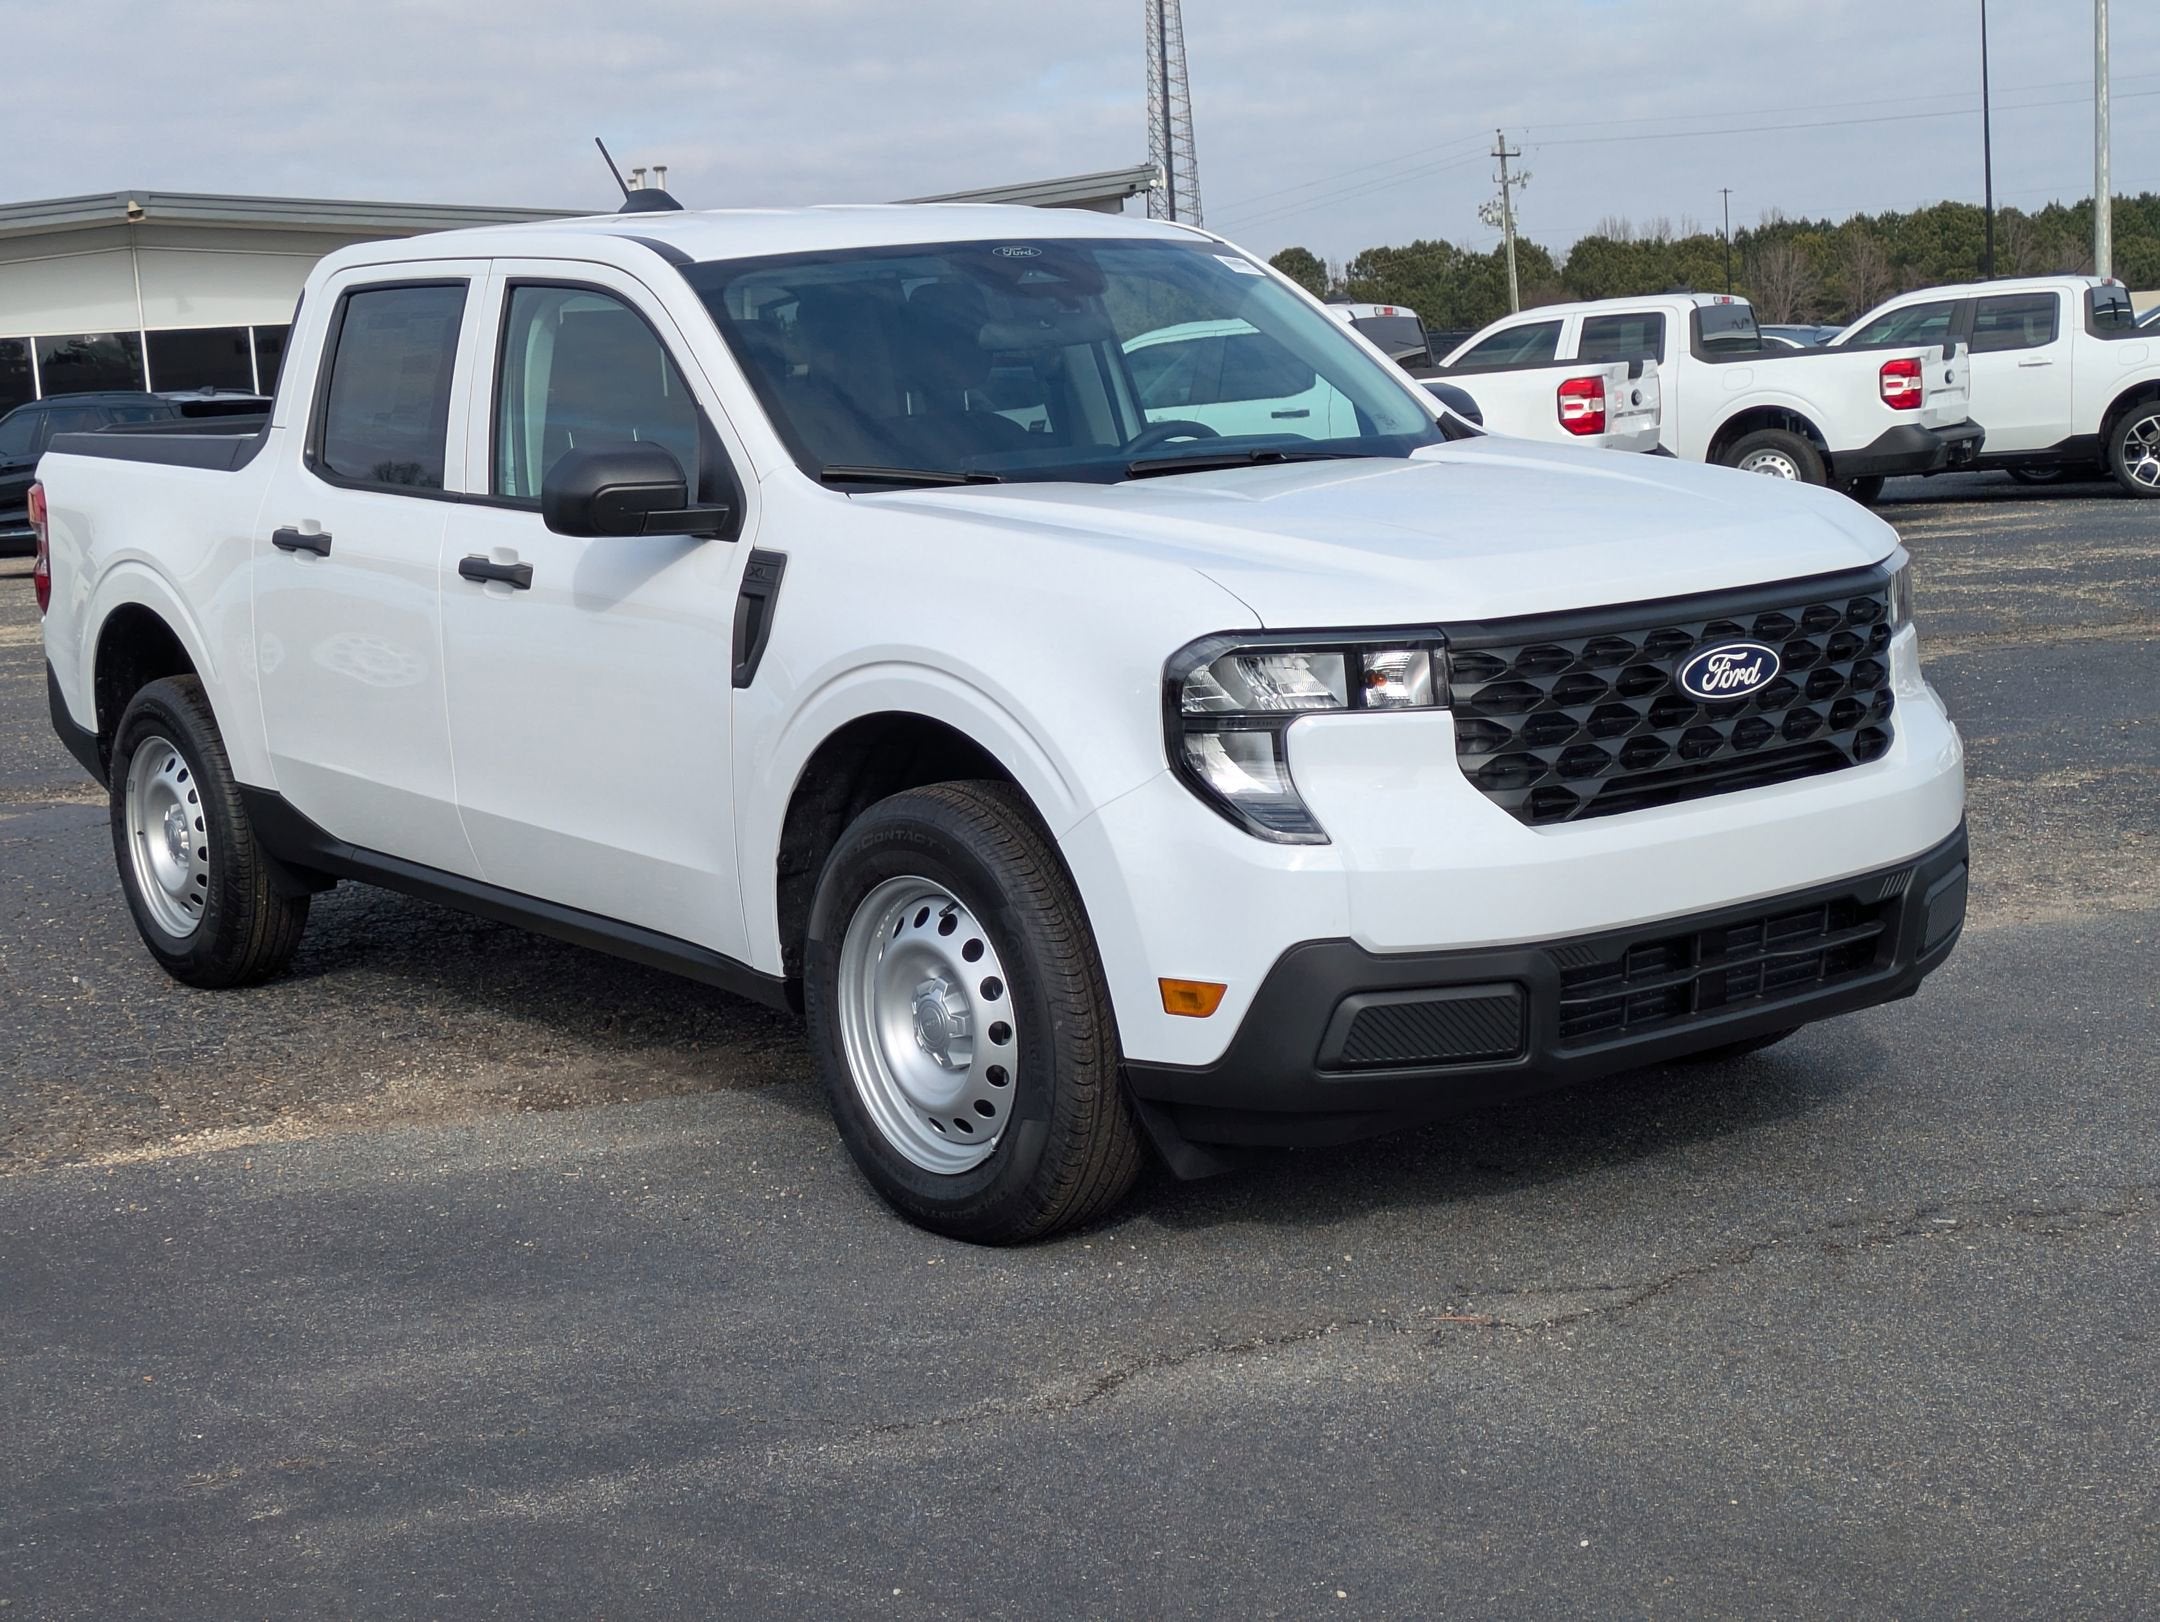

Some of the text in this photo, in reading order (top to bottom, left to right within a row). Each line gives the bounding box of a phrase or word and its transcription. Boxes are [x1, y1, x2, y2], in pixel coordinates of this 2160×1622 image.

[1003, 247, 1034, 256] Ford
[747, 566, 773, 581] XL
[1702, 651, 1763, 691] Ford
